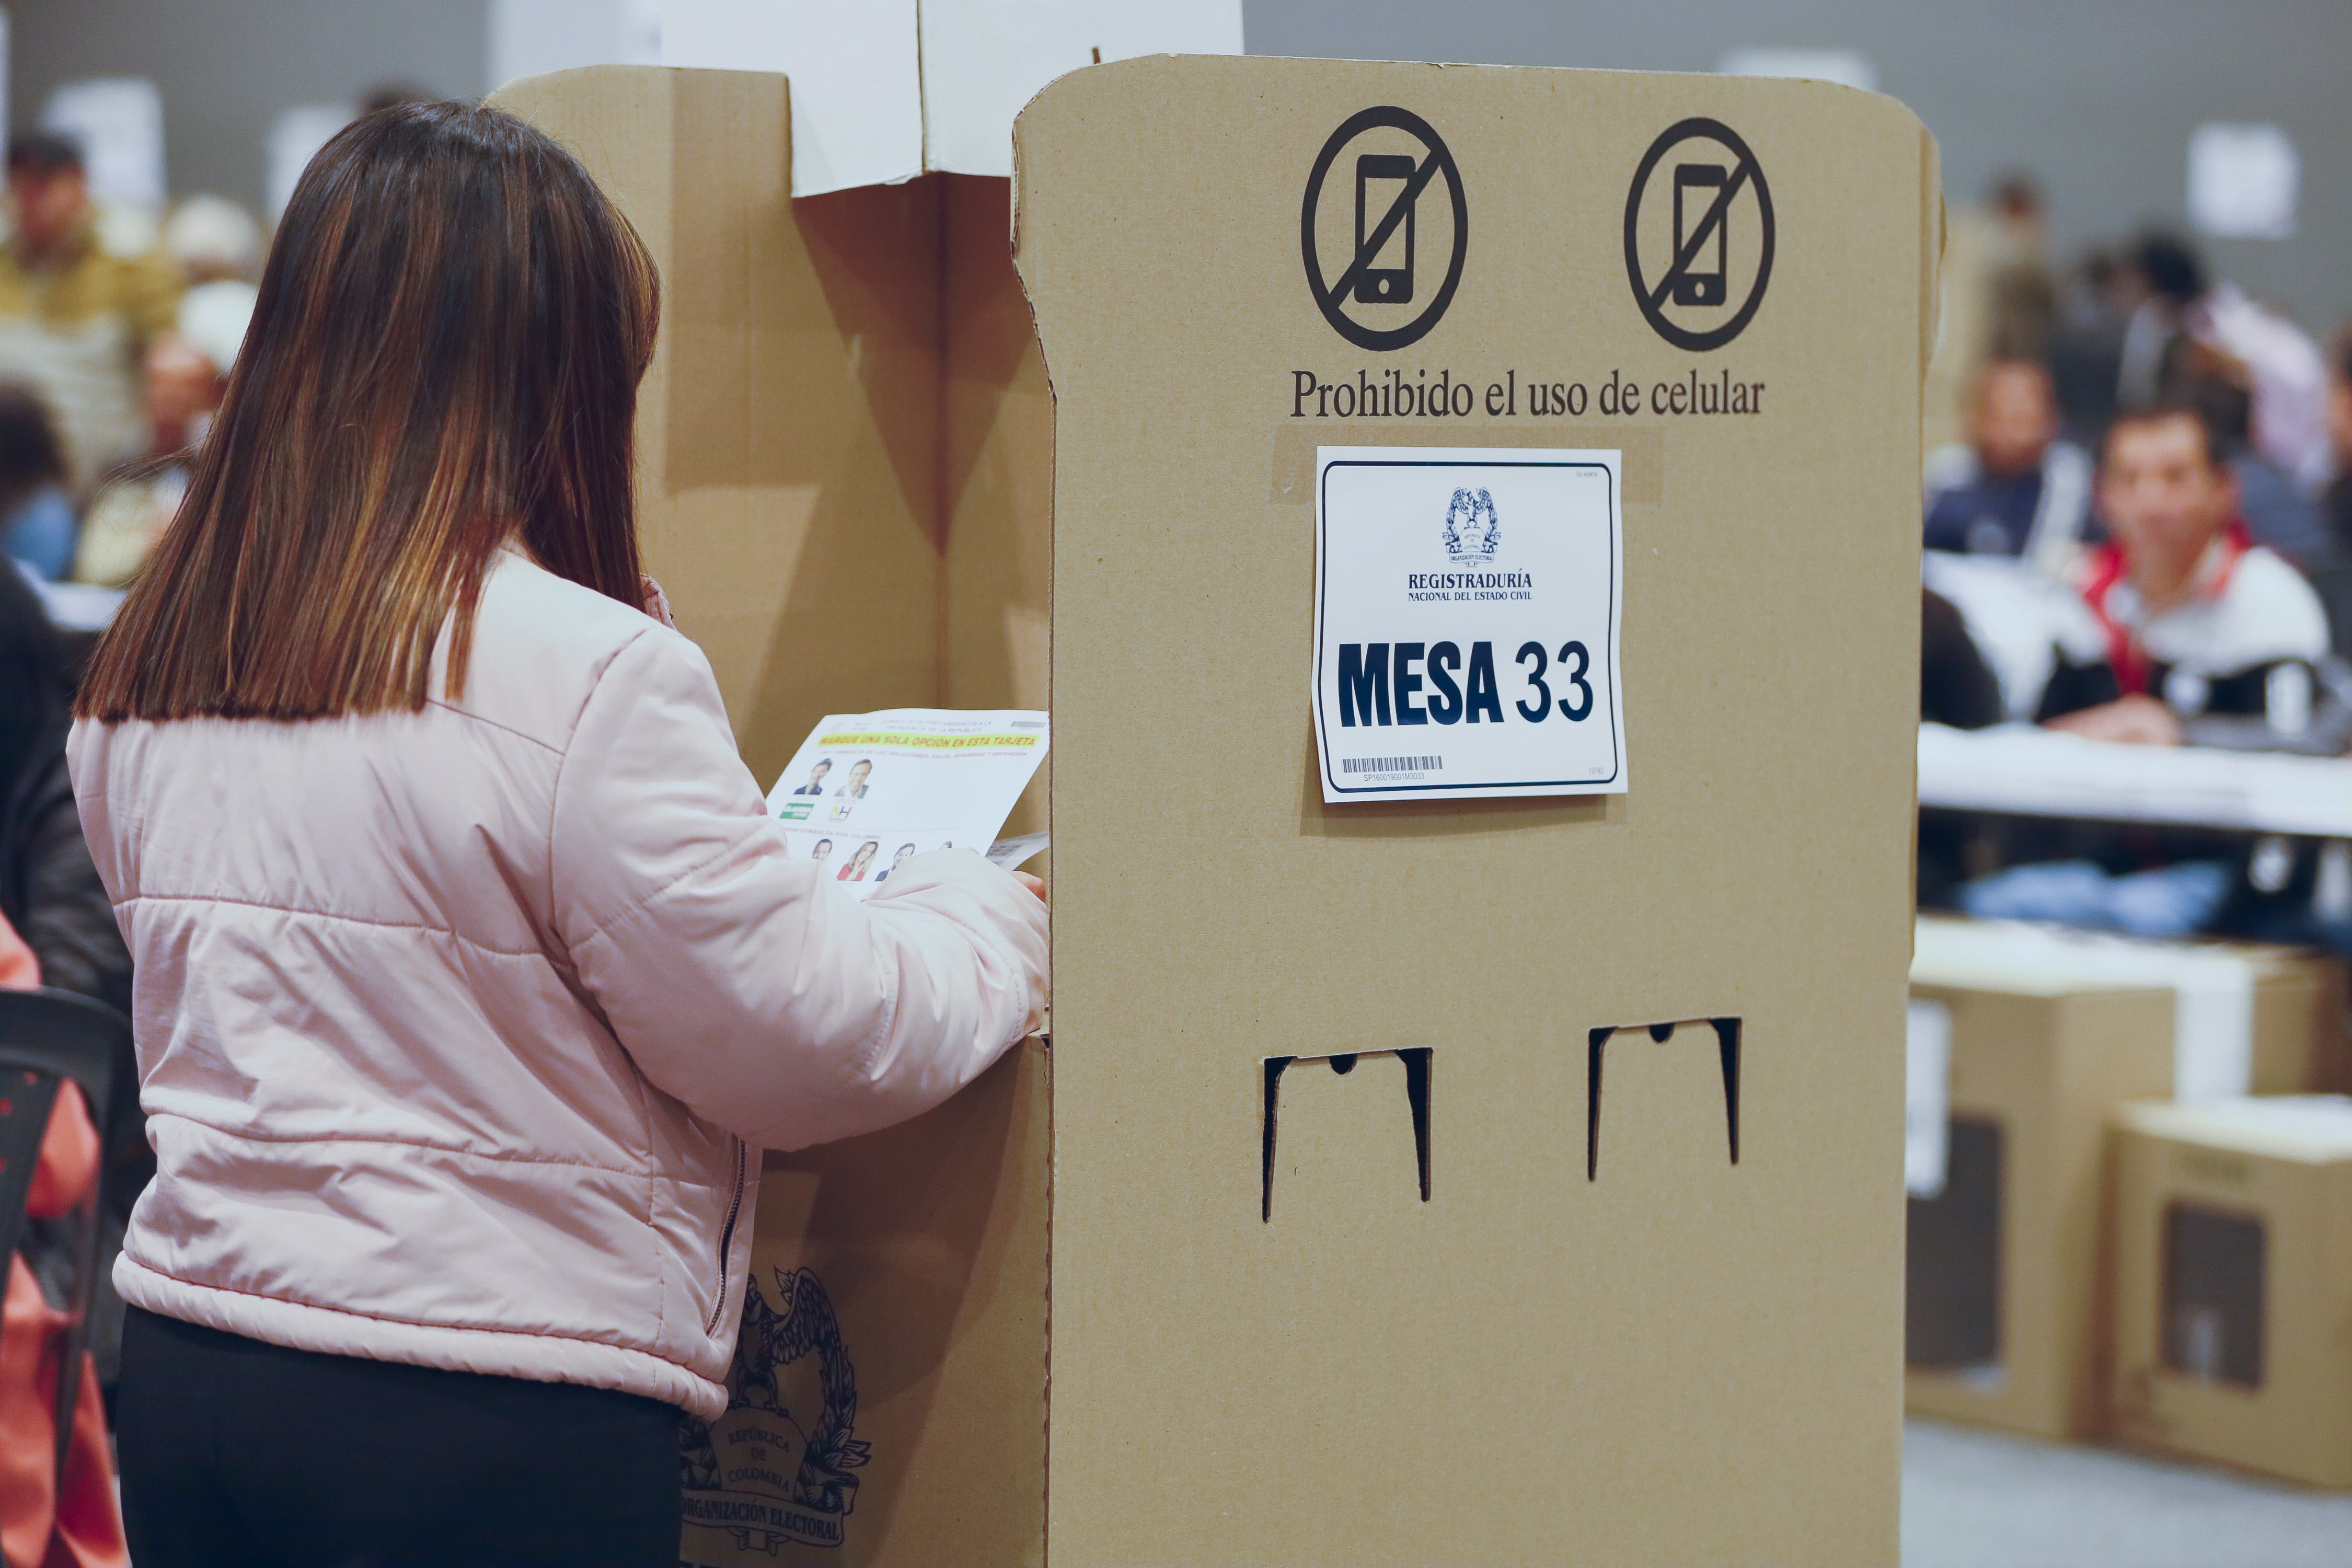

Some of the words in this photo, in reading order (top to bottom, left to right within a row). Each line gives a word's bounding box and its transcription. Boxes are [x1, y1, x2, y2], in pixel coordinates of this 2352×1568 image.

[1291, 370, 1473, 417] Prohibido
[1485, 370, 1515, 416] el
[1528, 382, 1587, 415] uso
[1599, 369, 1639, 414] de
[1651, 369, 1765, 414] celular
[1409, 568, 1532, 589] REGISTRADURÍA
[1409, 592, 1451, 601] NACIONAL
[1455, 592, 1471, 601] DEL
[1474, 592, 1507, 600] ESTADO
[1511, 591, 1532, 599] CIVIL
[1339, 641, 1504, 727] MESA
[1515, 641, 1593, 723] 33
[821, 735, 858, 744] MARQUE
[884, 735, 909, 745] SOLA
[912, 736, 950, 747] OPCIÓN
[952, 738, 966, 747] EN
[967, 737, 990, 746] ESTA
[994, 737, 1035, 745] TARJETA
[728, 1426, 790, 1453] REPÚBLICA
[750, 1447, 767, 1461] DE
[728, 1468, 789, 1493] COLOMBIA
[770, 1509, 839, 1540] ELECTORAL
